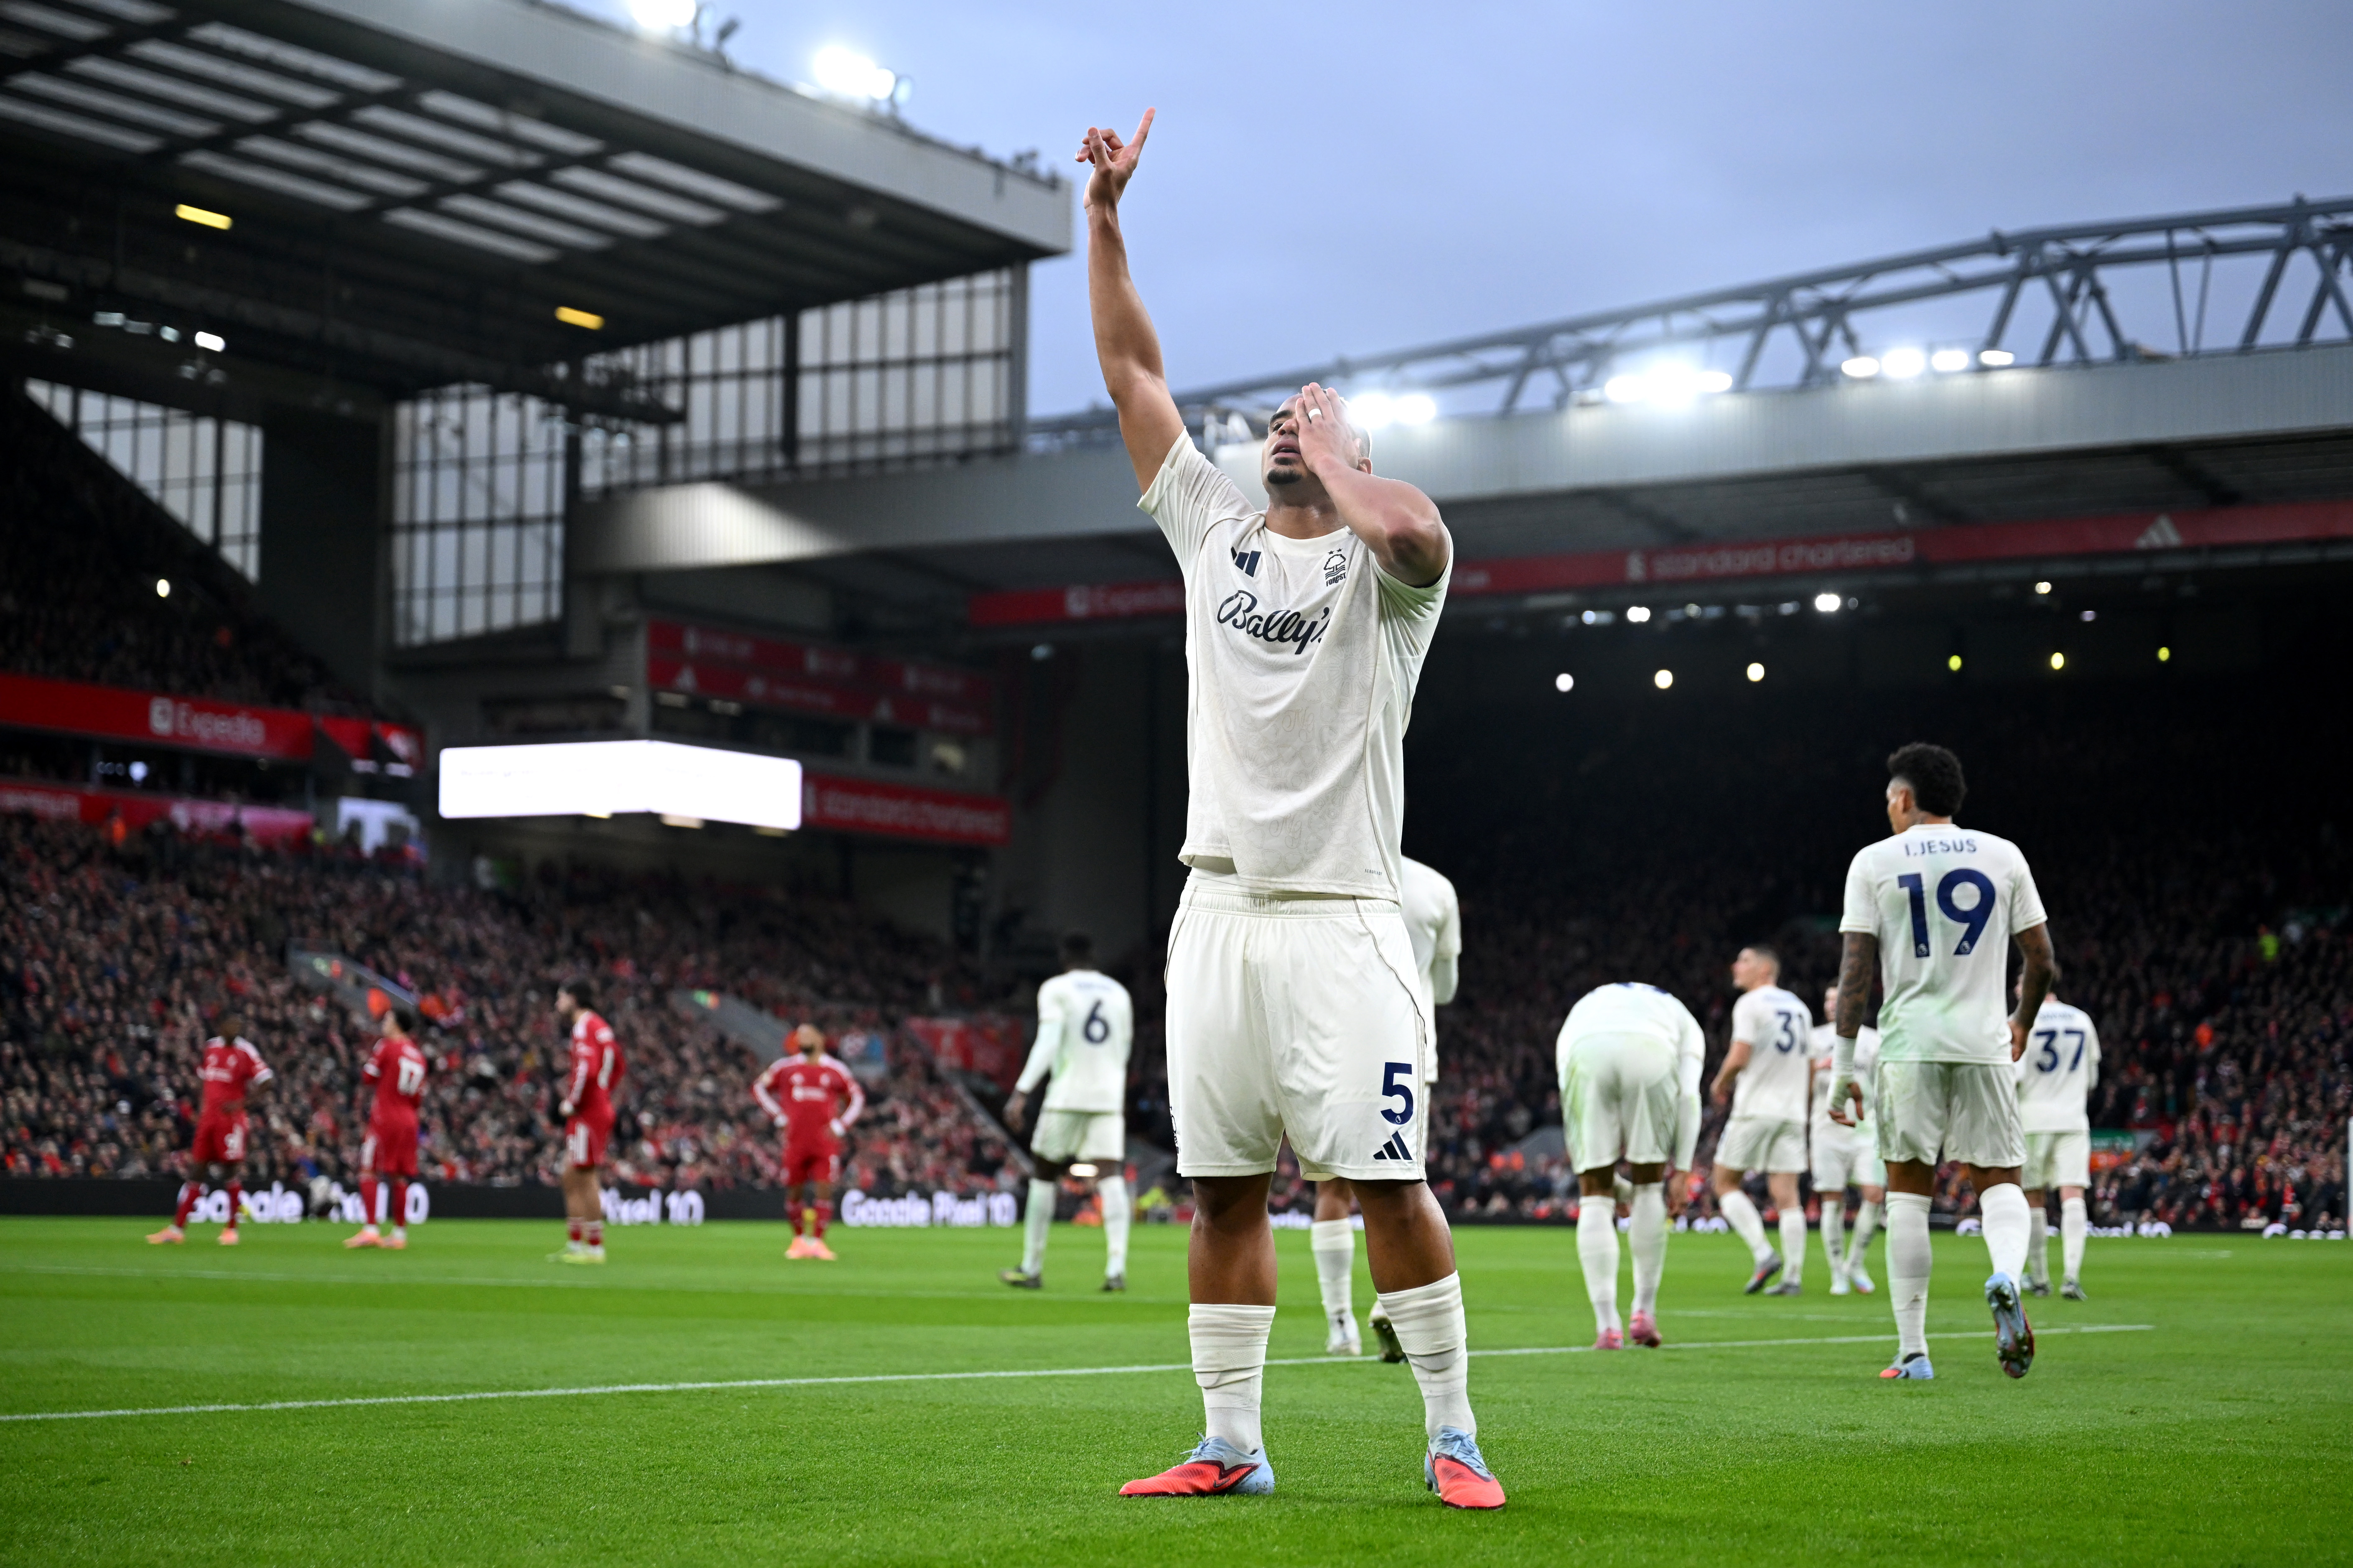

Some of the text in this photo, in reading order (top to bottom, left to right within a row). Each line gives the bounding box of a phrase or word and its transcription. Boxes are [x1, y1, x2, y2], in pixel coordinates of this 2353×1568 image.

[1904, 838, 1977, 857] I.JESUS
[1897, 867, 1996, 959] 19
[1083, 998, 1110, 1044] 6
[1775, 1010, 1807, 1054] 31
[2035, 1029, 2085, 1072] 37
[1380, 1062, 1413, 1125] 5
[665, 1189, 705, 1227] 10
[840, 1189, 1018, 1227] Google Pixel 10
